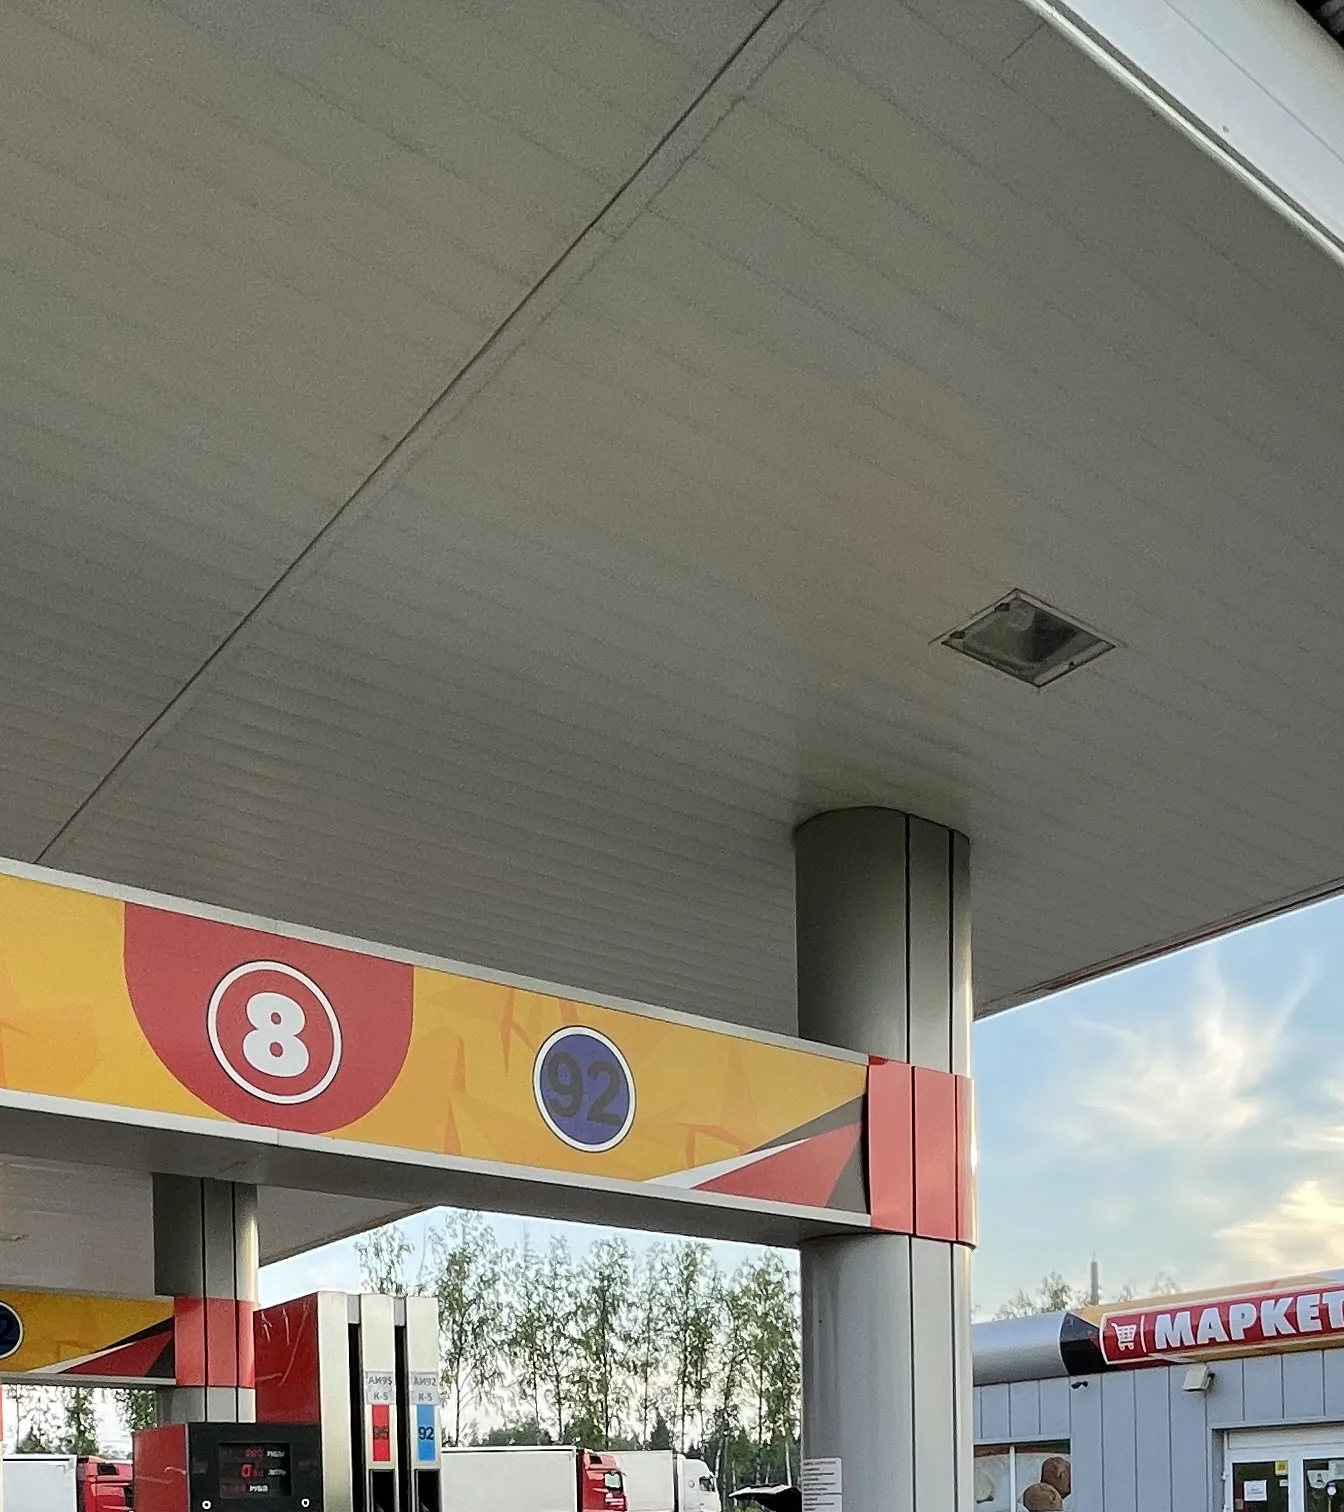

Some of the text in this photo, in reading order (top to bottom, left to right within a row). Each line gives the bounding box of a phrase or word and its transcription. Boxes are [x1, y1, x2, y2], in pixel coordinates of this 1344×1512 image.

[241, 992, 311, 1079] 8
[547, 1051, 625, 1127] 92
[417, 1426, 435, 1441] 92
